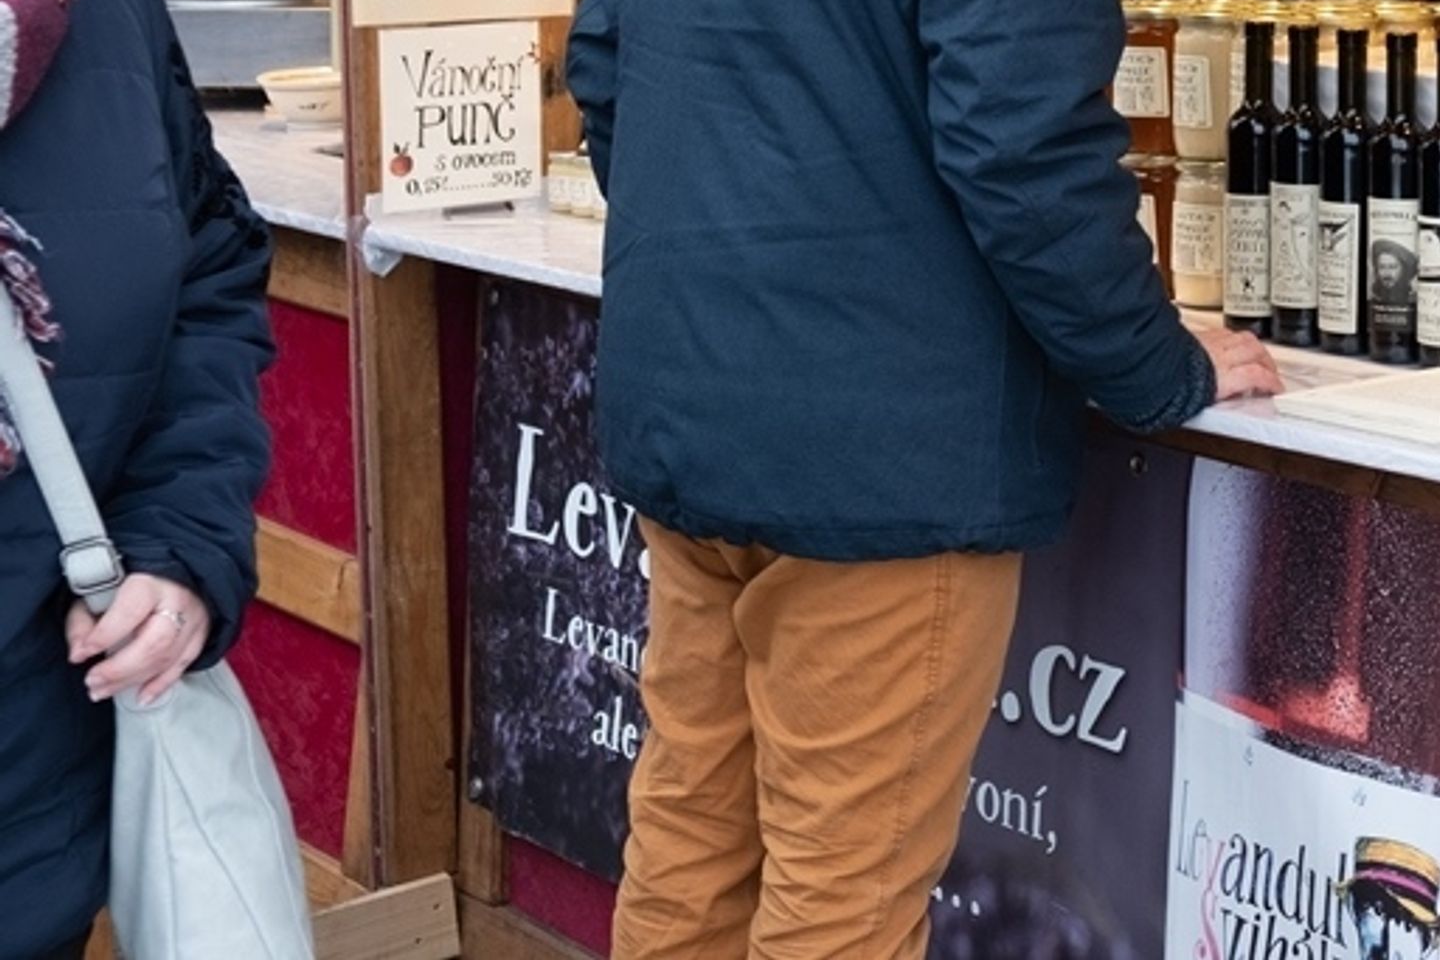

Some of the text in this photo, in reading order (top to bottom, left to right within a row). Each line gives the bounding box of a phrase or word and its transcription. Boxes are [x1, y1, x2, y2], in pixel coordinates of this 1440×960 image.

[401, 49, 525, 99] Vánoční
[542, 588, 650, 673] Levan
[591, 695, 638, 761] ale
